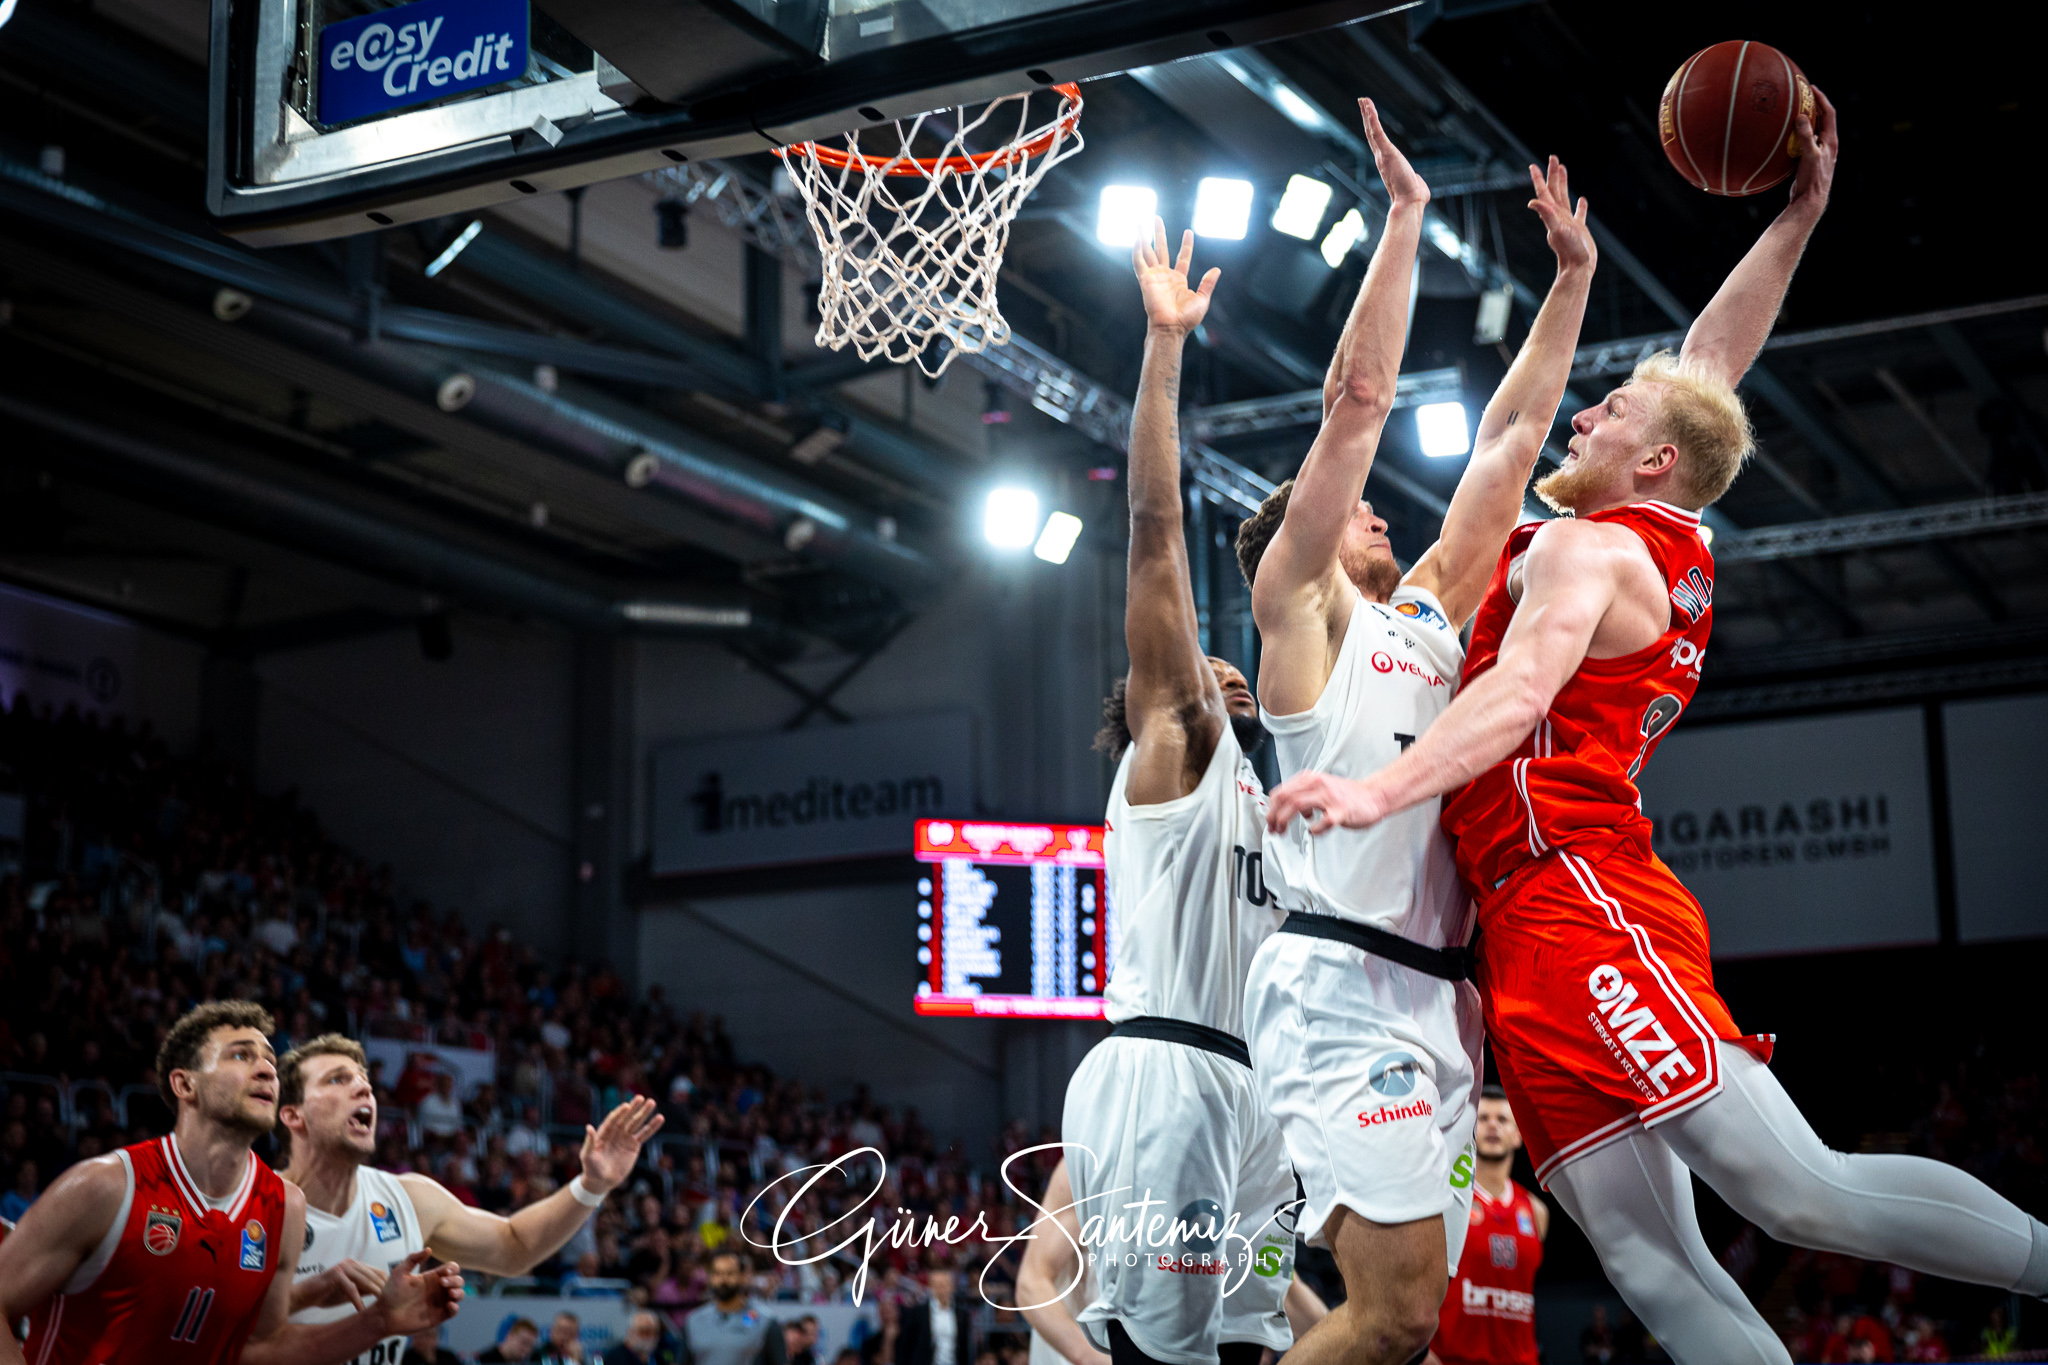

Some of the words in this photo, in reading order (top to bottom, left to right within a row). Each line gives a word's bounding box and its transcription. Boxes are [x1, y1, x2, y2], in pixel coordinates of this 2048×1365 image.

[383, 32, 514, 97] Credit
[1234, 845, 1281, 909] TO
[1588, 1011, 1618, 1051] STIRKAT
[1614, 1050, 1622, 1060] &
[1357, 1099, 1432, 1129] Schindle
[170, 1285, 216, 1344] 11
